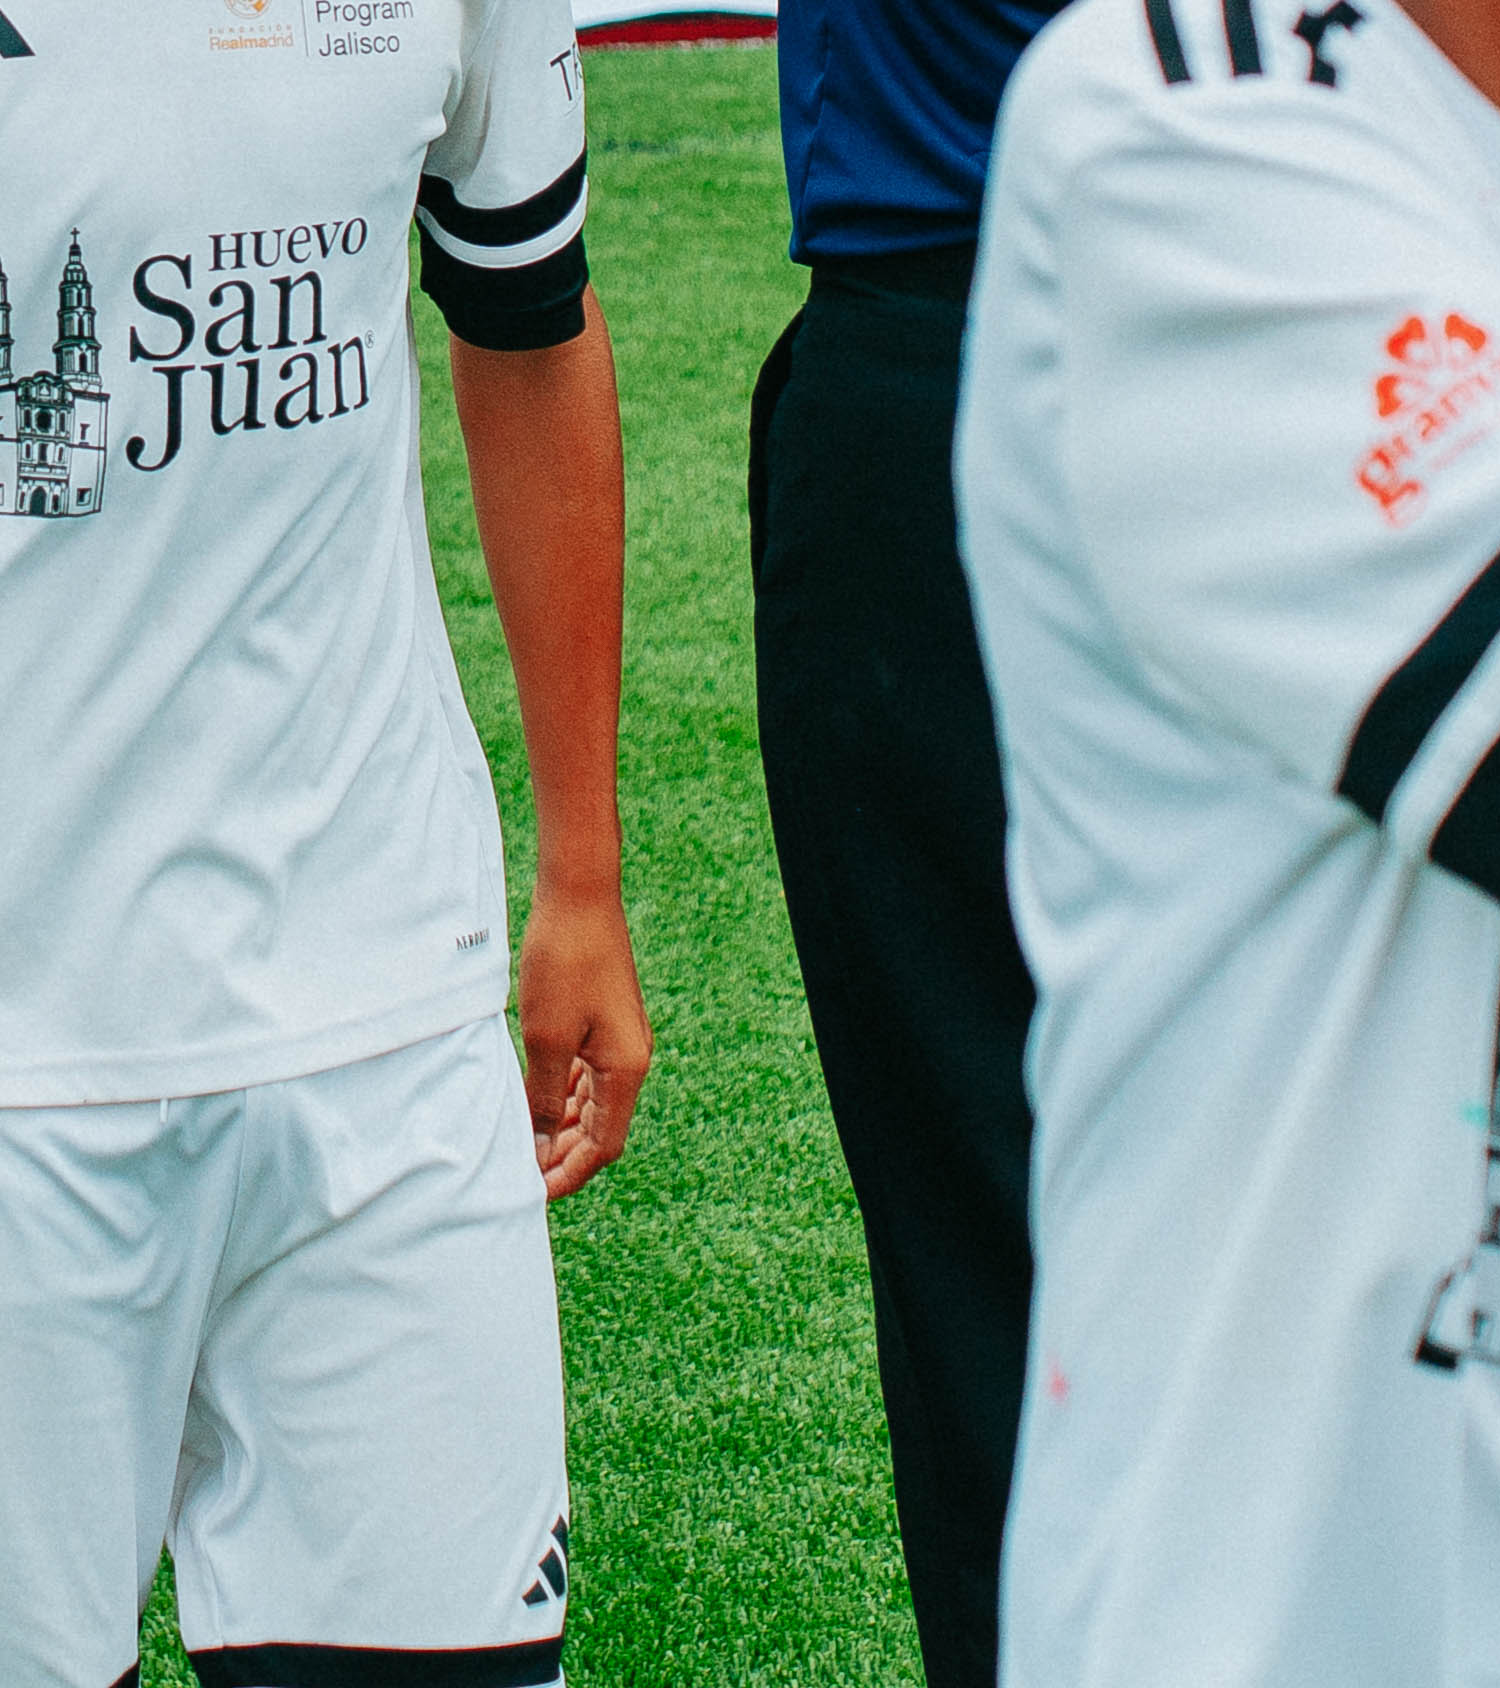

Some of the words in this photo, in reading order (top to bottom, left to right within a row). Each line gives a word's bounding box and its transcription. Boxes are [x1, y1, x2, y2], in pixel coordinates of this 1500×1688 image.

[315, 0, 414, 27] Program
[318, 31, 401, 57] Jalisco
[129, 253, 328, 363] San
